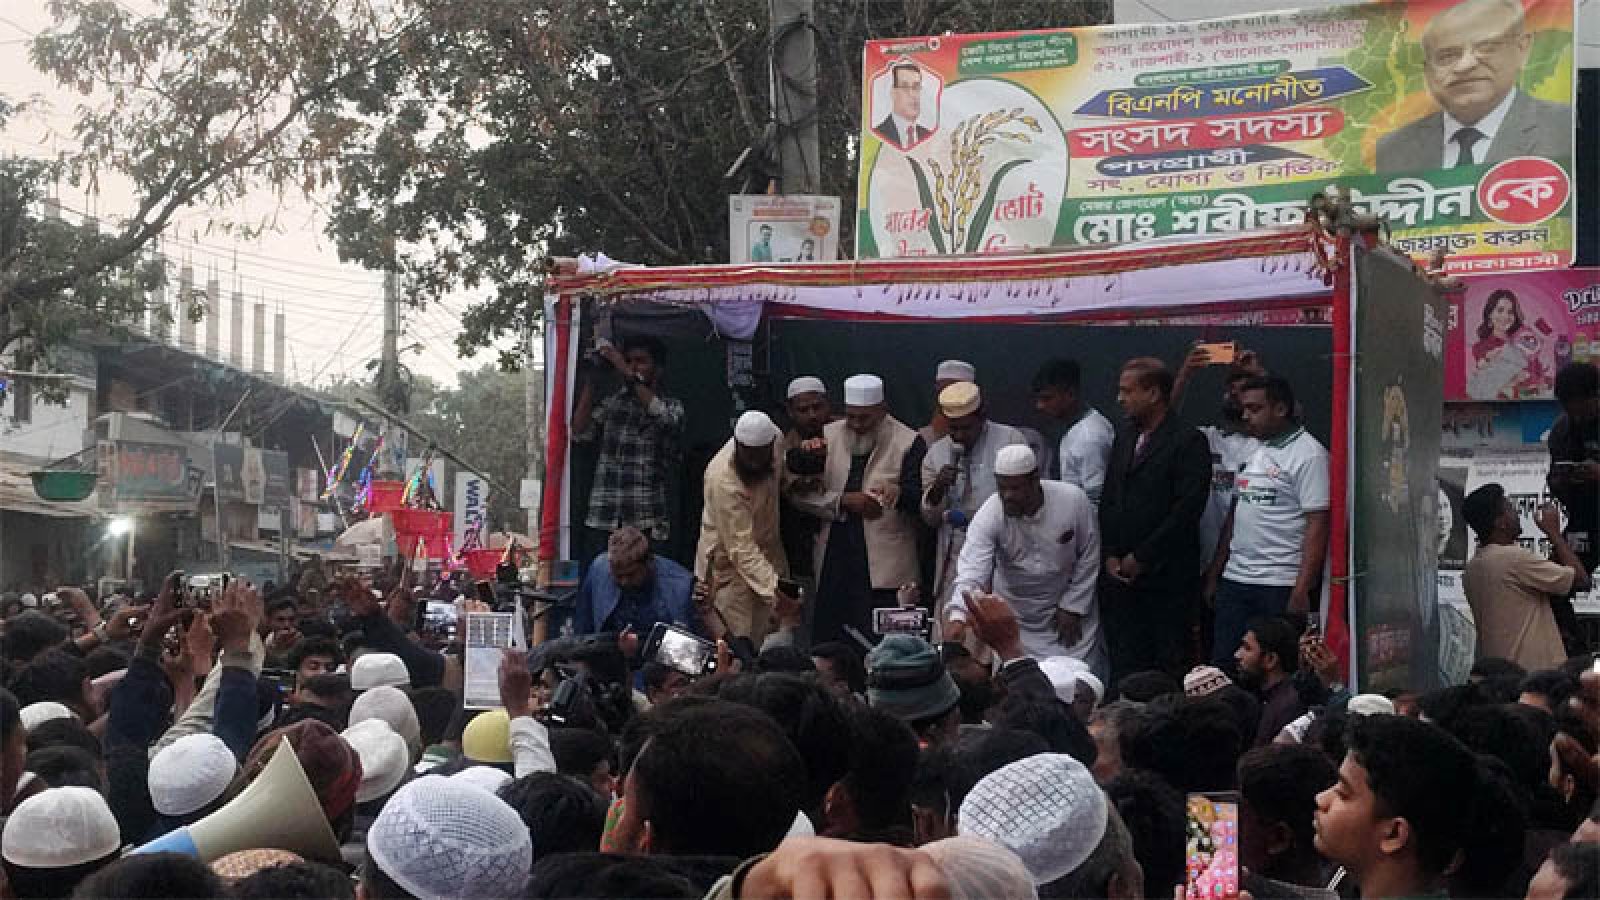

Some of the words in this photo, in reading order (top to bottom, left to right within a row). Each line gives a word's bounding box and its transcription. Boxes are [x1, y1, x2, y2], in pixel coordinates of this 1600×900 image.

[1106, 85, 1203, 117] বিএনপি
[1211, 76, 1325, 107] মনোনীত
[1079, 122, 1197, 153] সংসদ
[1205, 111, 1333, 142] সদস্য
[993, 181, 1045, 222] ভোট
[1073, 210, 1157, 246] মোঃ
[1487, 176, 1559, 210] কে
[1444, 253, 1560, 271] লাকাবাসী
